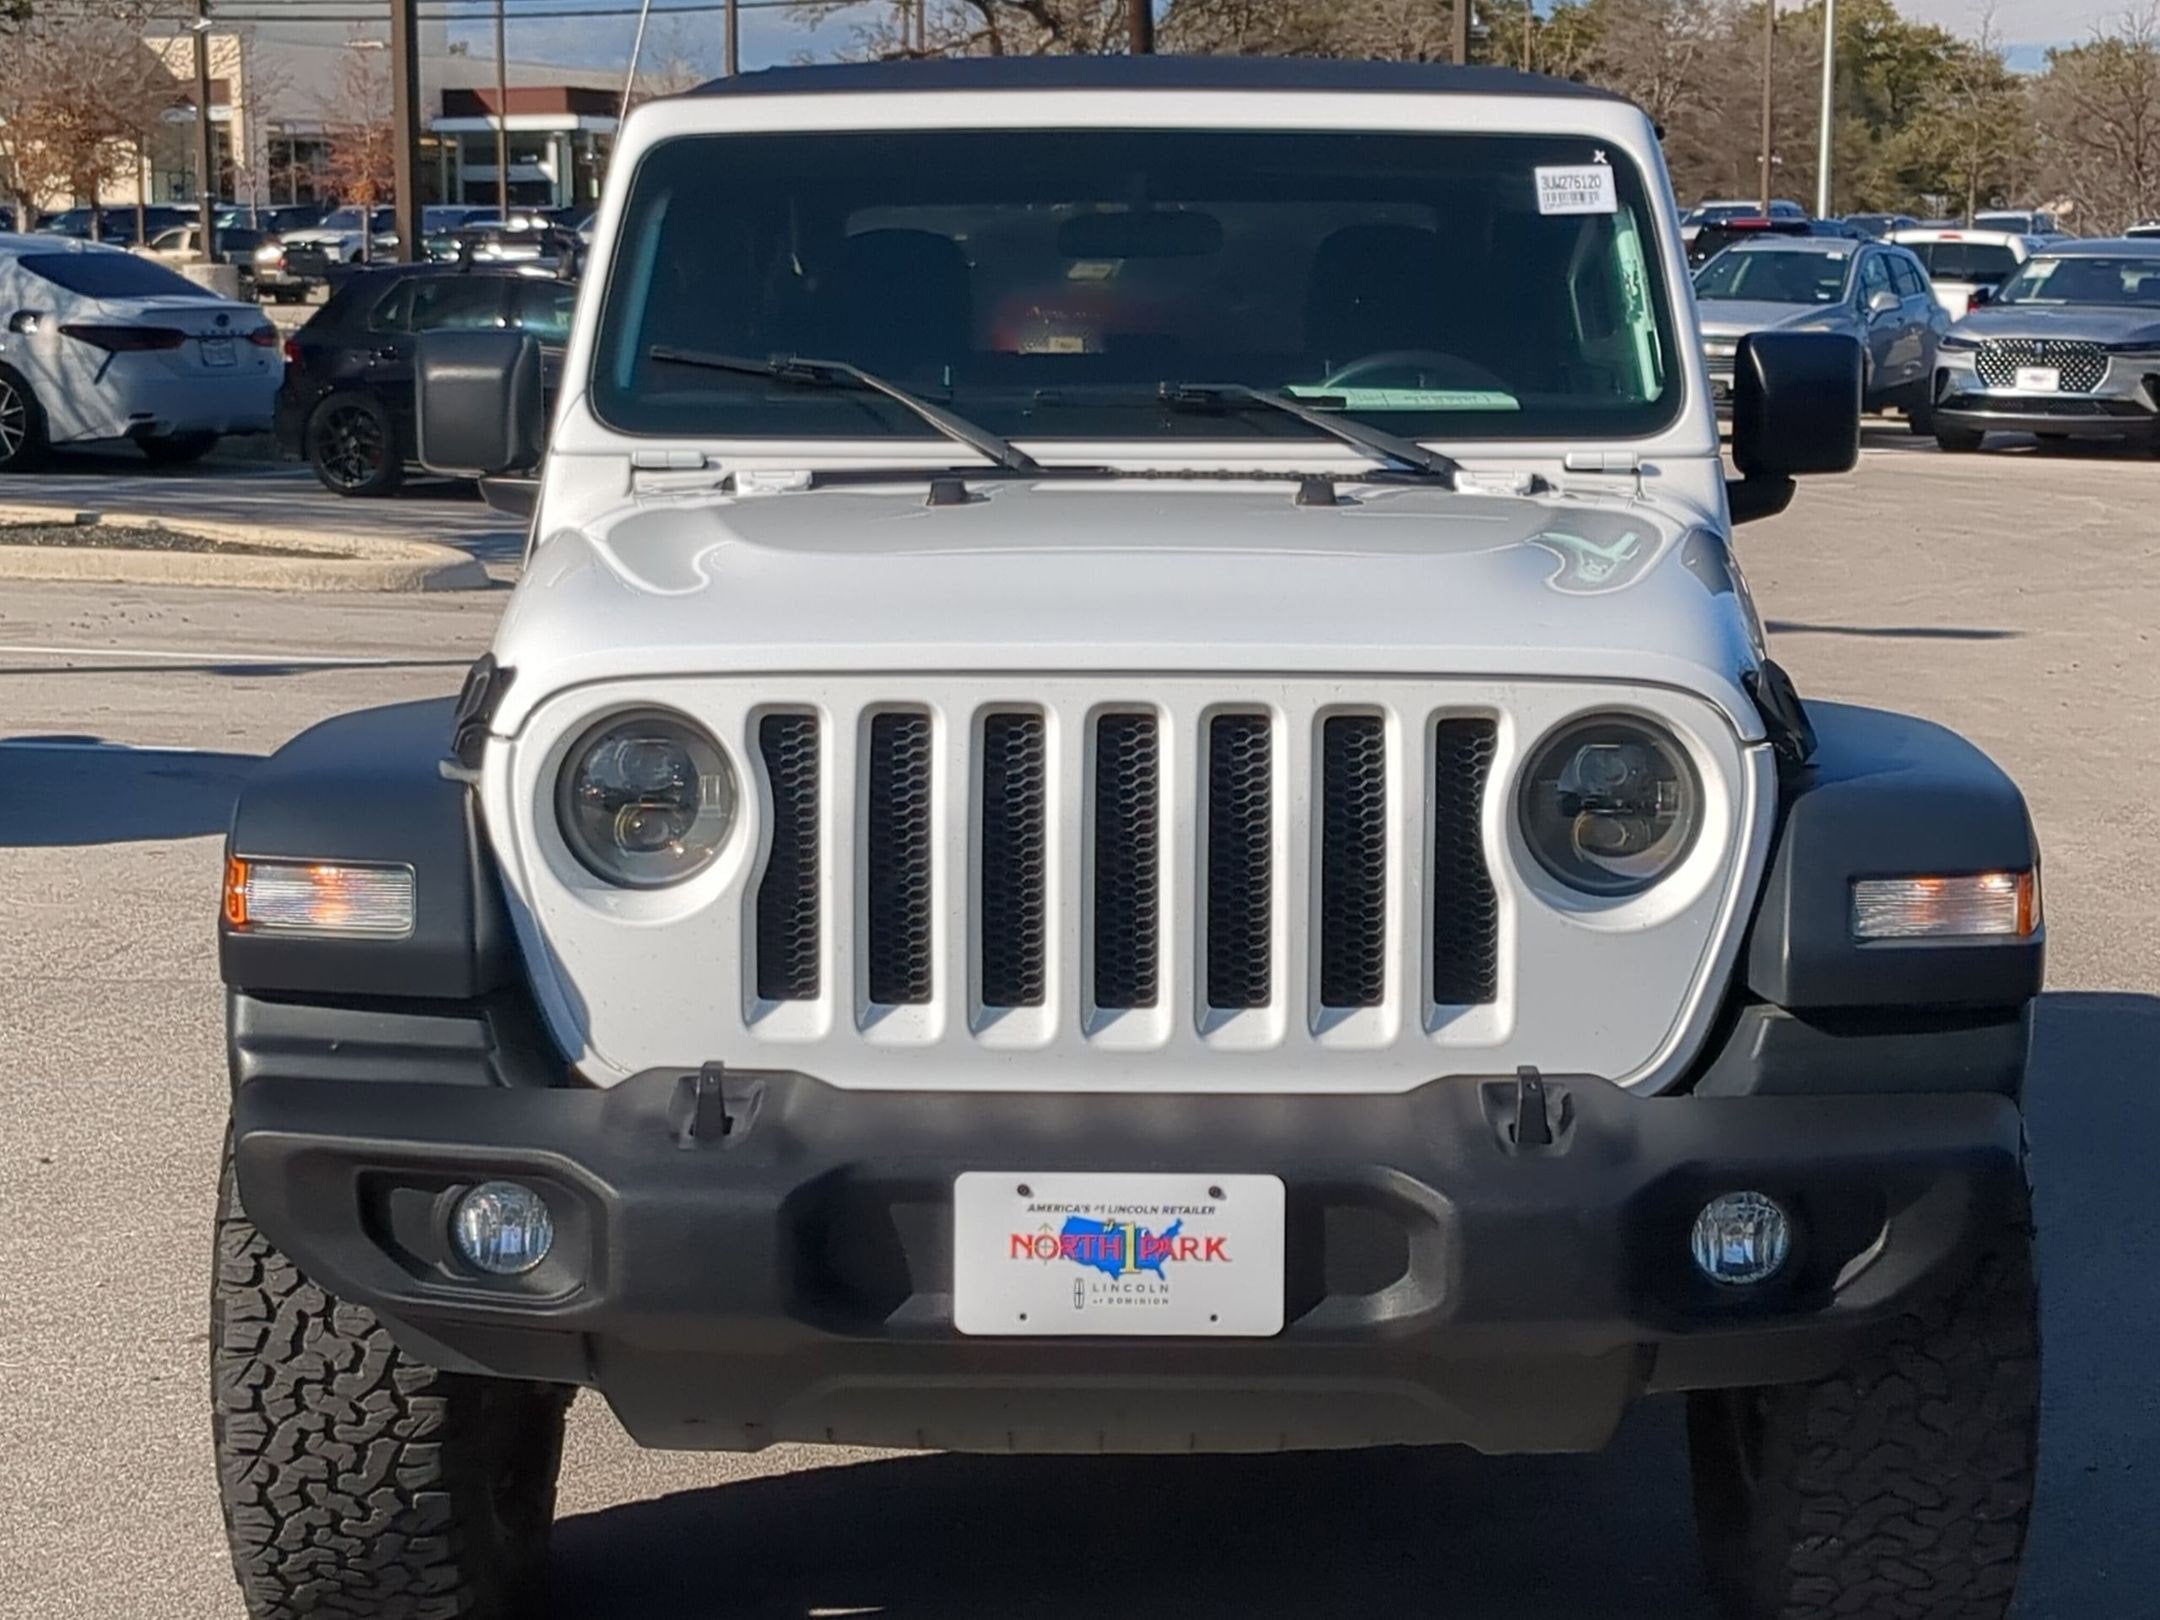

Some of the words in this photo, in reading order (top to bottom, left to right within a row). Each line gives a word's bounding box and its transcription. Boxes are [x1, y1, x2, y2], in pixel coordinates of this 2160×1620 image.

[1027, 1204, 1091, 1213] AMERICA'S
[1107, 1205, 1159, 1214] LINCOLN
[1161, 1206, 1215, 1215] RETAILER
[1011, 1234, 1122, 1260] NORTH
[1142, 1235, 1232, 1262] PARK
[1092, 1284, 1169, 1293] LINCOLN
